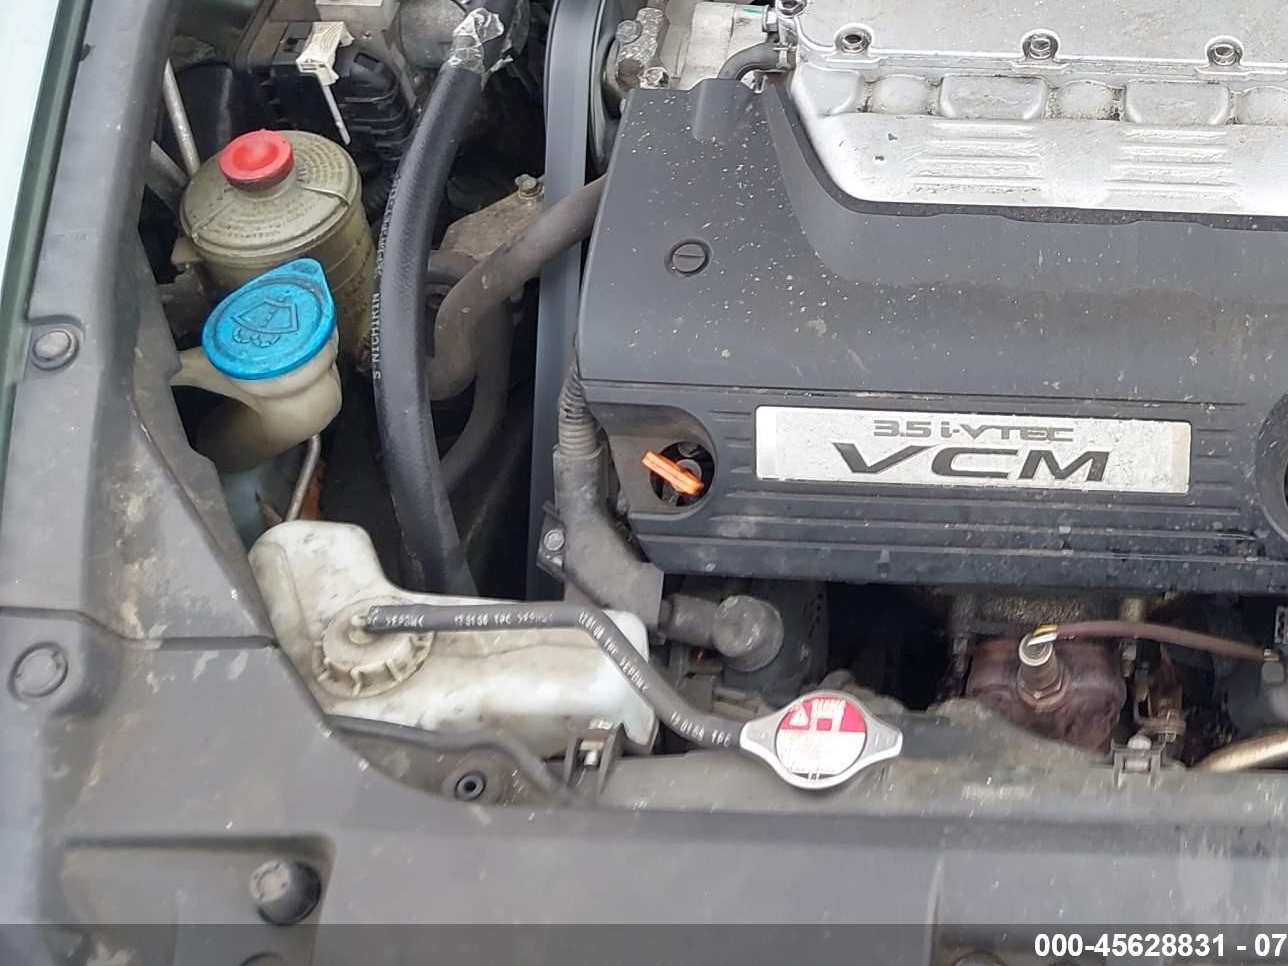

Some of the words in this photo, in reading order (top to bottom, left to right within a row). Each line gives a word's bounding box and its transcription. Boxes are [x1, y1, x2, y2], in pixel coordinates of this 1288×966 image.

[873, 419, 931, 437] 3.5
[940, 421, 1075, 443] i-VTEC
[832, 442, 1113, 482] VCM
